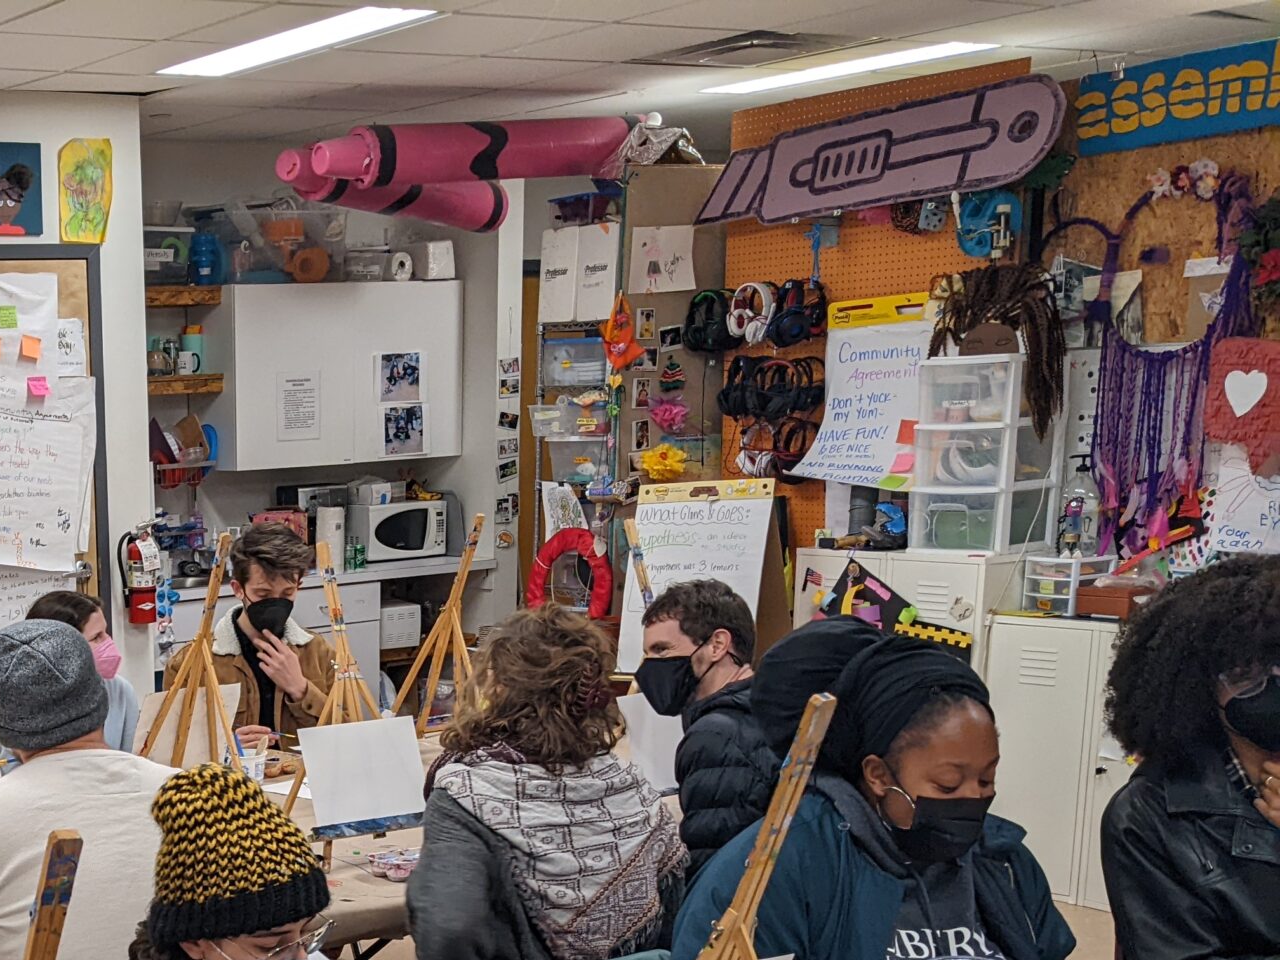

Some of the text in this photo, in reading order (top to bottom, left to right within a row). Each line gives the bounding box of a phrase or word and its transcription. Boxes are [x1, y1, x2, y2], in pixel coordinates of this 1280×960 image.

[838, 342, 921, 365] Community
[820, 425, 889, 443] HAVE FUN!
[828, 443, 844, 455] BE
[847, 442, 872, 454] NICE
[698, 559, 707, 572] 3
